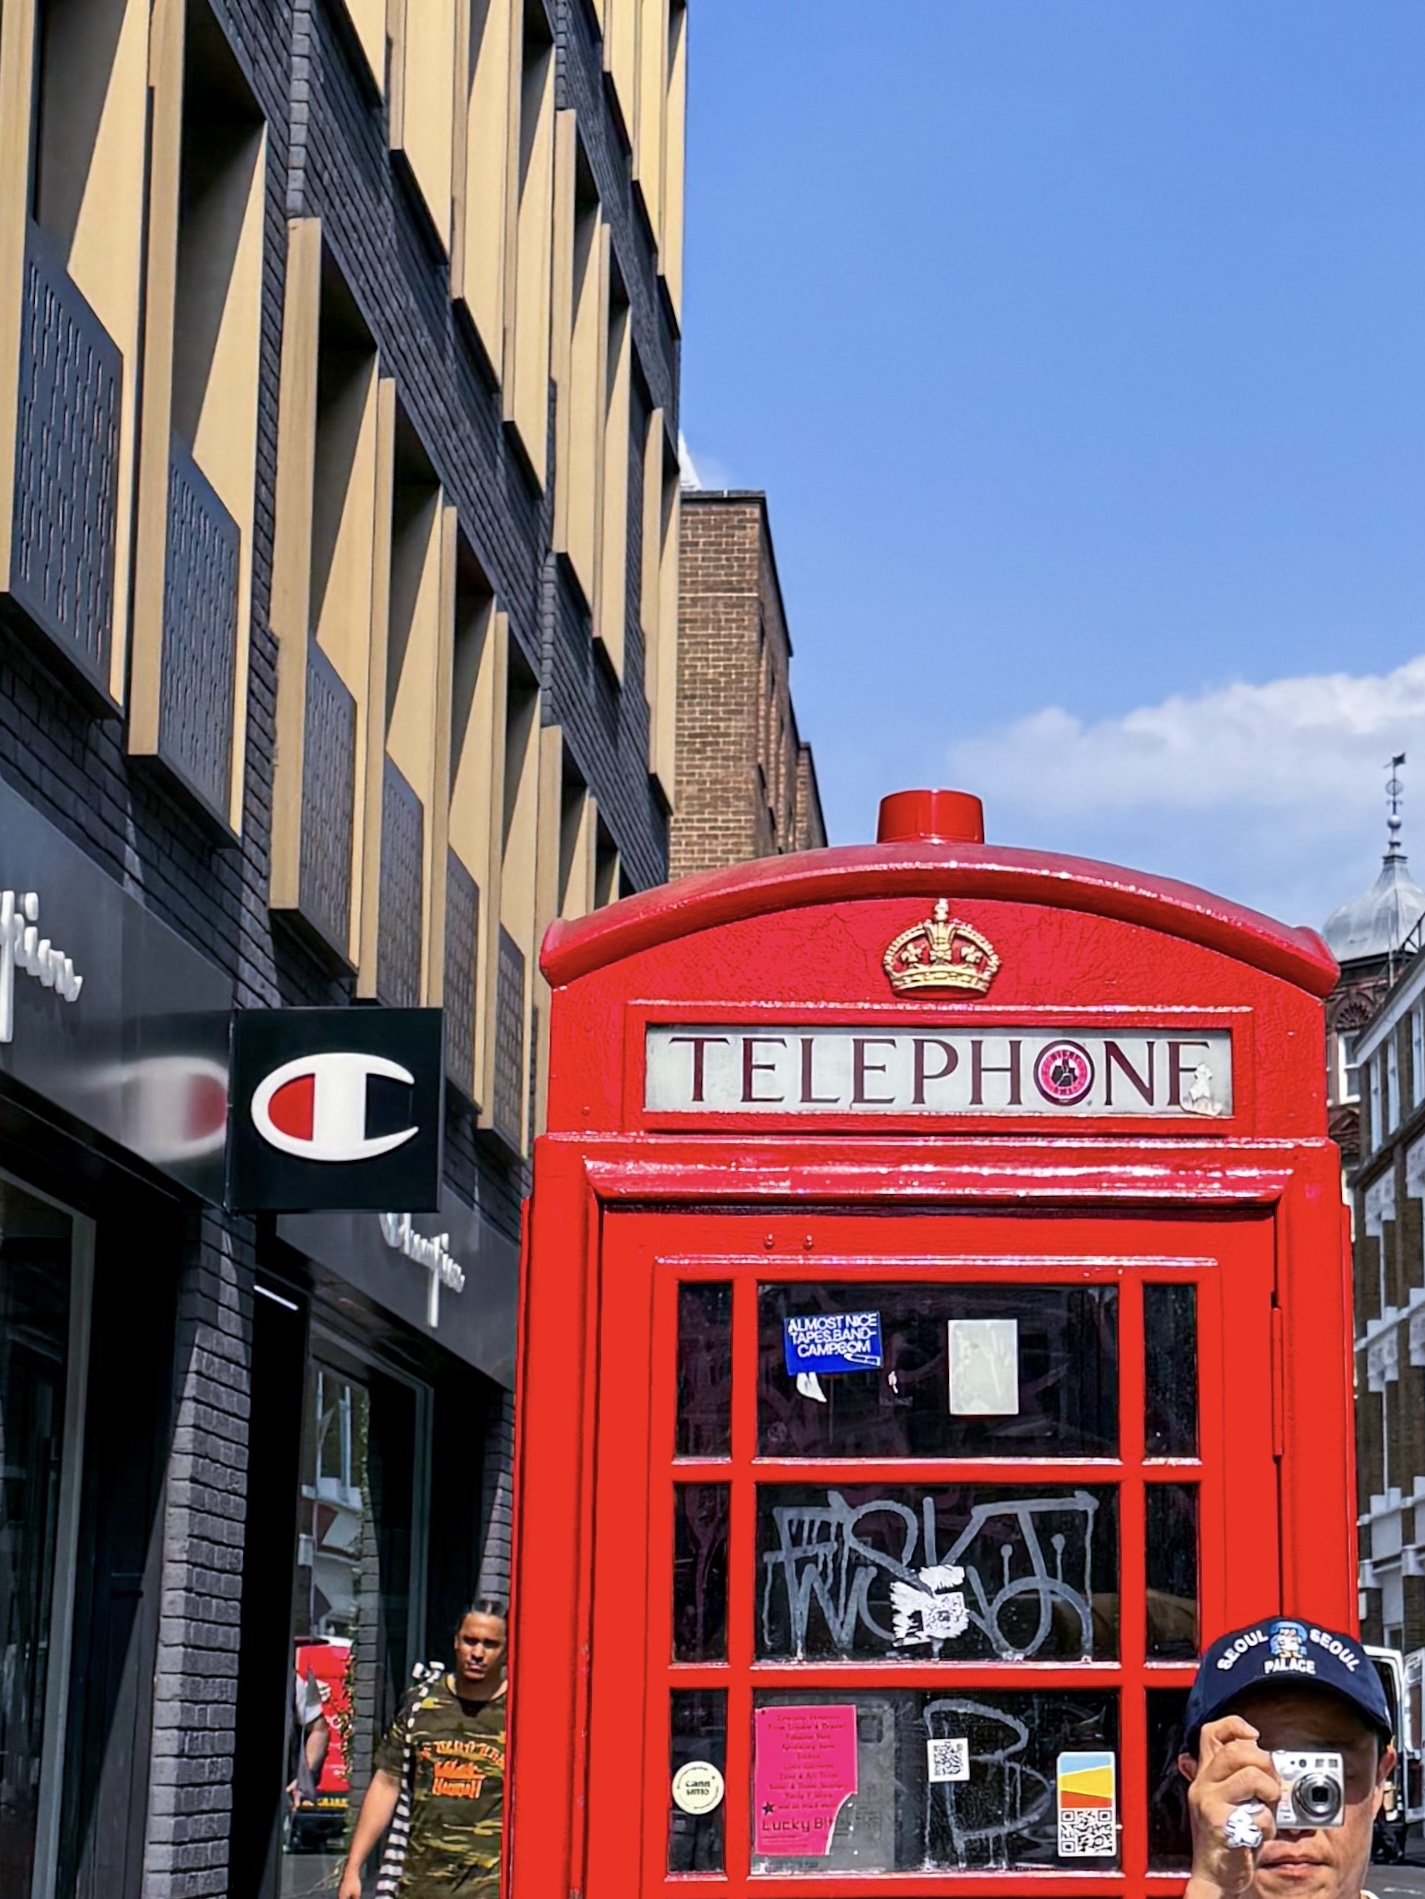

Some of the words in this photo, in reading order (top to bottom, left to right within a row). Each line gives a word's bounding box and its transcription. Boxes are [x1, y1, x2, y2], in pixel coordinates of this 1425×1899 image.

[668, 1038, 1210, 1107] TELEPHONE
[788, 1316, 844, 1334] ALMOST
[845, 1313, 877, 1327] NICE
[1216, 1629, 1269, 1671] SEOUL
[1309, 1628, 1360, 1672] SEOUL
[1264, 1657, 1316, 1675] PALACE
[762, 1818, 811, 1834] Lucky
